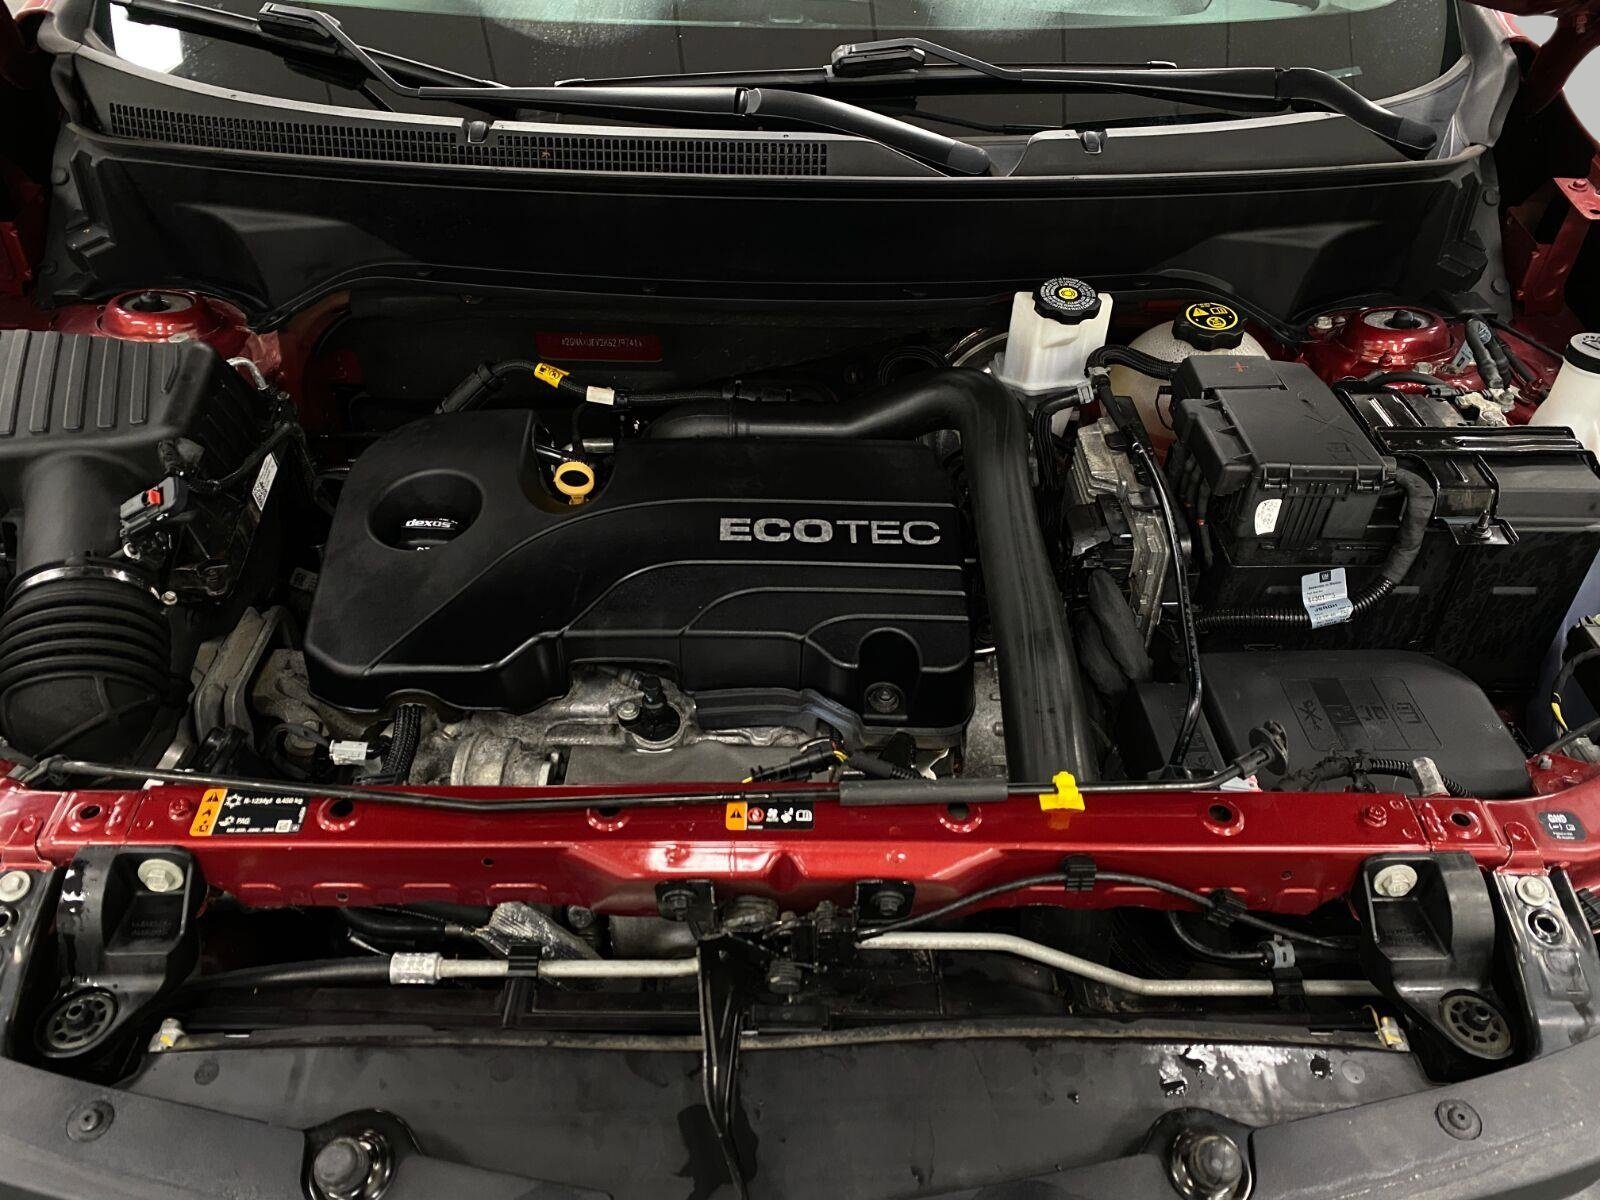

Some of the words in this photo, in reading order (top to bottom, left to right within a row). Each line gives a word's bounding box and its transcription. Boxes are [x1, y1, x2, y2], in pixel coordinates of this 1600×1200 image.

[405, 518, 451, 528] dexos
[719, 517, 941, 546] ECOTEC
[236, 817, 251, 825] PAG
[1547, 813, 1567, 823] GND
